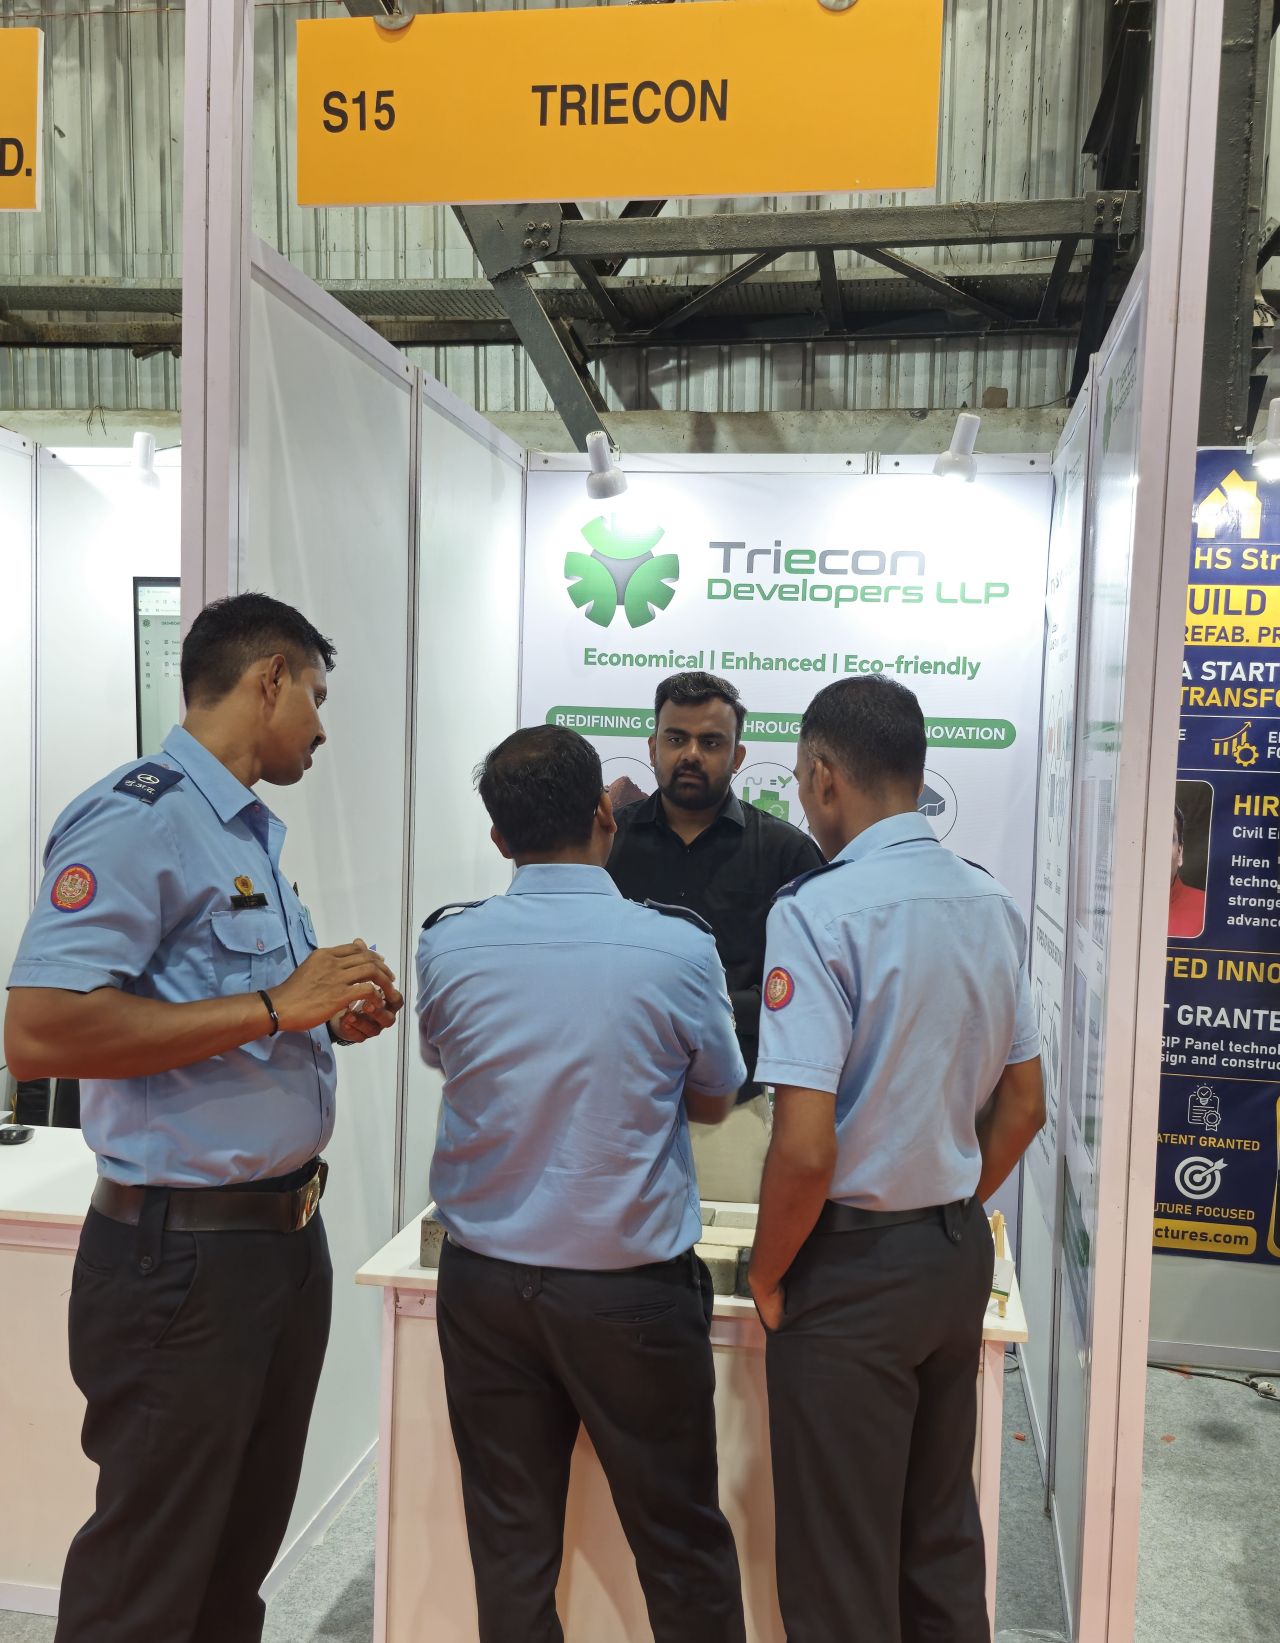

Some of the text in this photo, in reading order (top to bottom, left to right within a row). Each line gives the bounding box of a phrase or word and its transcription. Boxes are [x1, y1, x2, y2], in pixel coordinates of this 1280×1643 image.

[322, 79, 728, 133] S15 TRIECON
[709, 540, 925, 576] Triecon
[1194, 547, 1231, 569] HS
[707, 578, 1009, 608] Developers LLP
[1189, 588, 1266, 616] UILD
[584, 648, 704, 669] Economical
[721, 651, 826, 672] Enhanced
[844, 654, 981, 680] Eco-friendly
[1201, 661, 1280, 682] START
[556, 714, 641, 729] REDIFINING
[1233, 794, 1279, 817] HIR
[1232, 826, 1263, 839] Civil
[1231, 855, 1270, 868] Hiren
[1229, 875, 1280, 890] techno
[1177, 1004, 1280, 1032] GRANTE
[1185, 1037, 1224, 1051] Panel
[1191, 1054, 1217, 1066] and
[1200, 1136, 1260, 1151] GRANTED
[1196, 1205, 1255, 1221] FOCUSED
[1154, 1225, 1249, 1246] ctures.com
